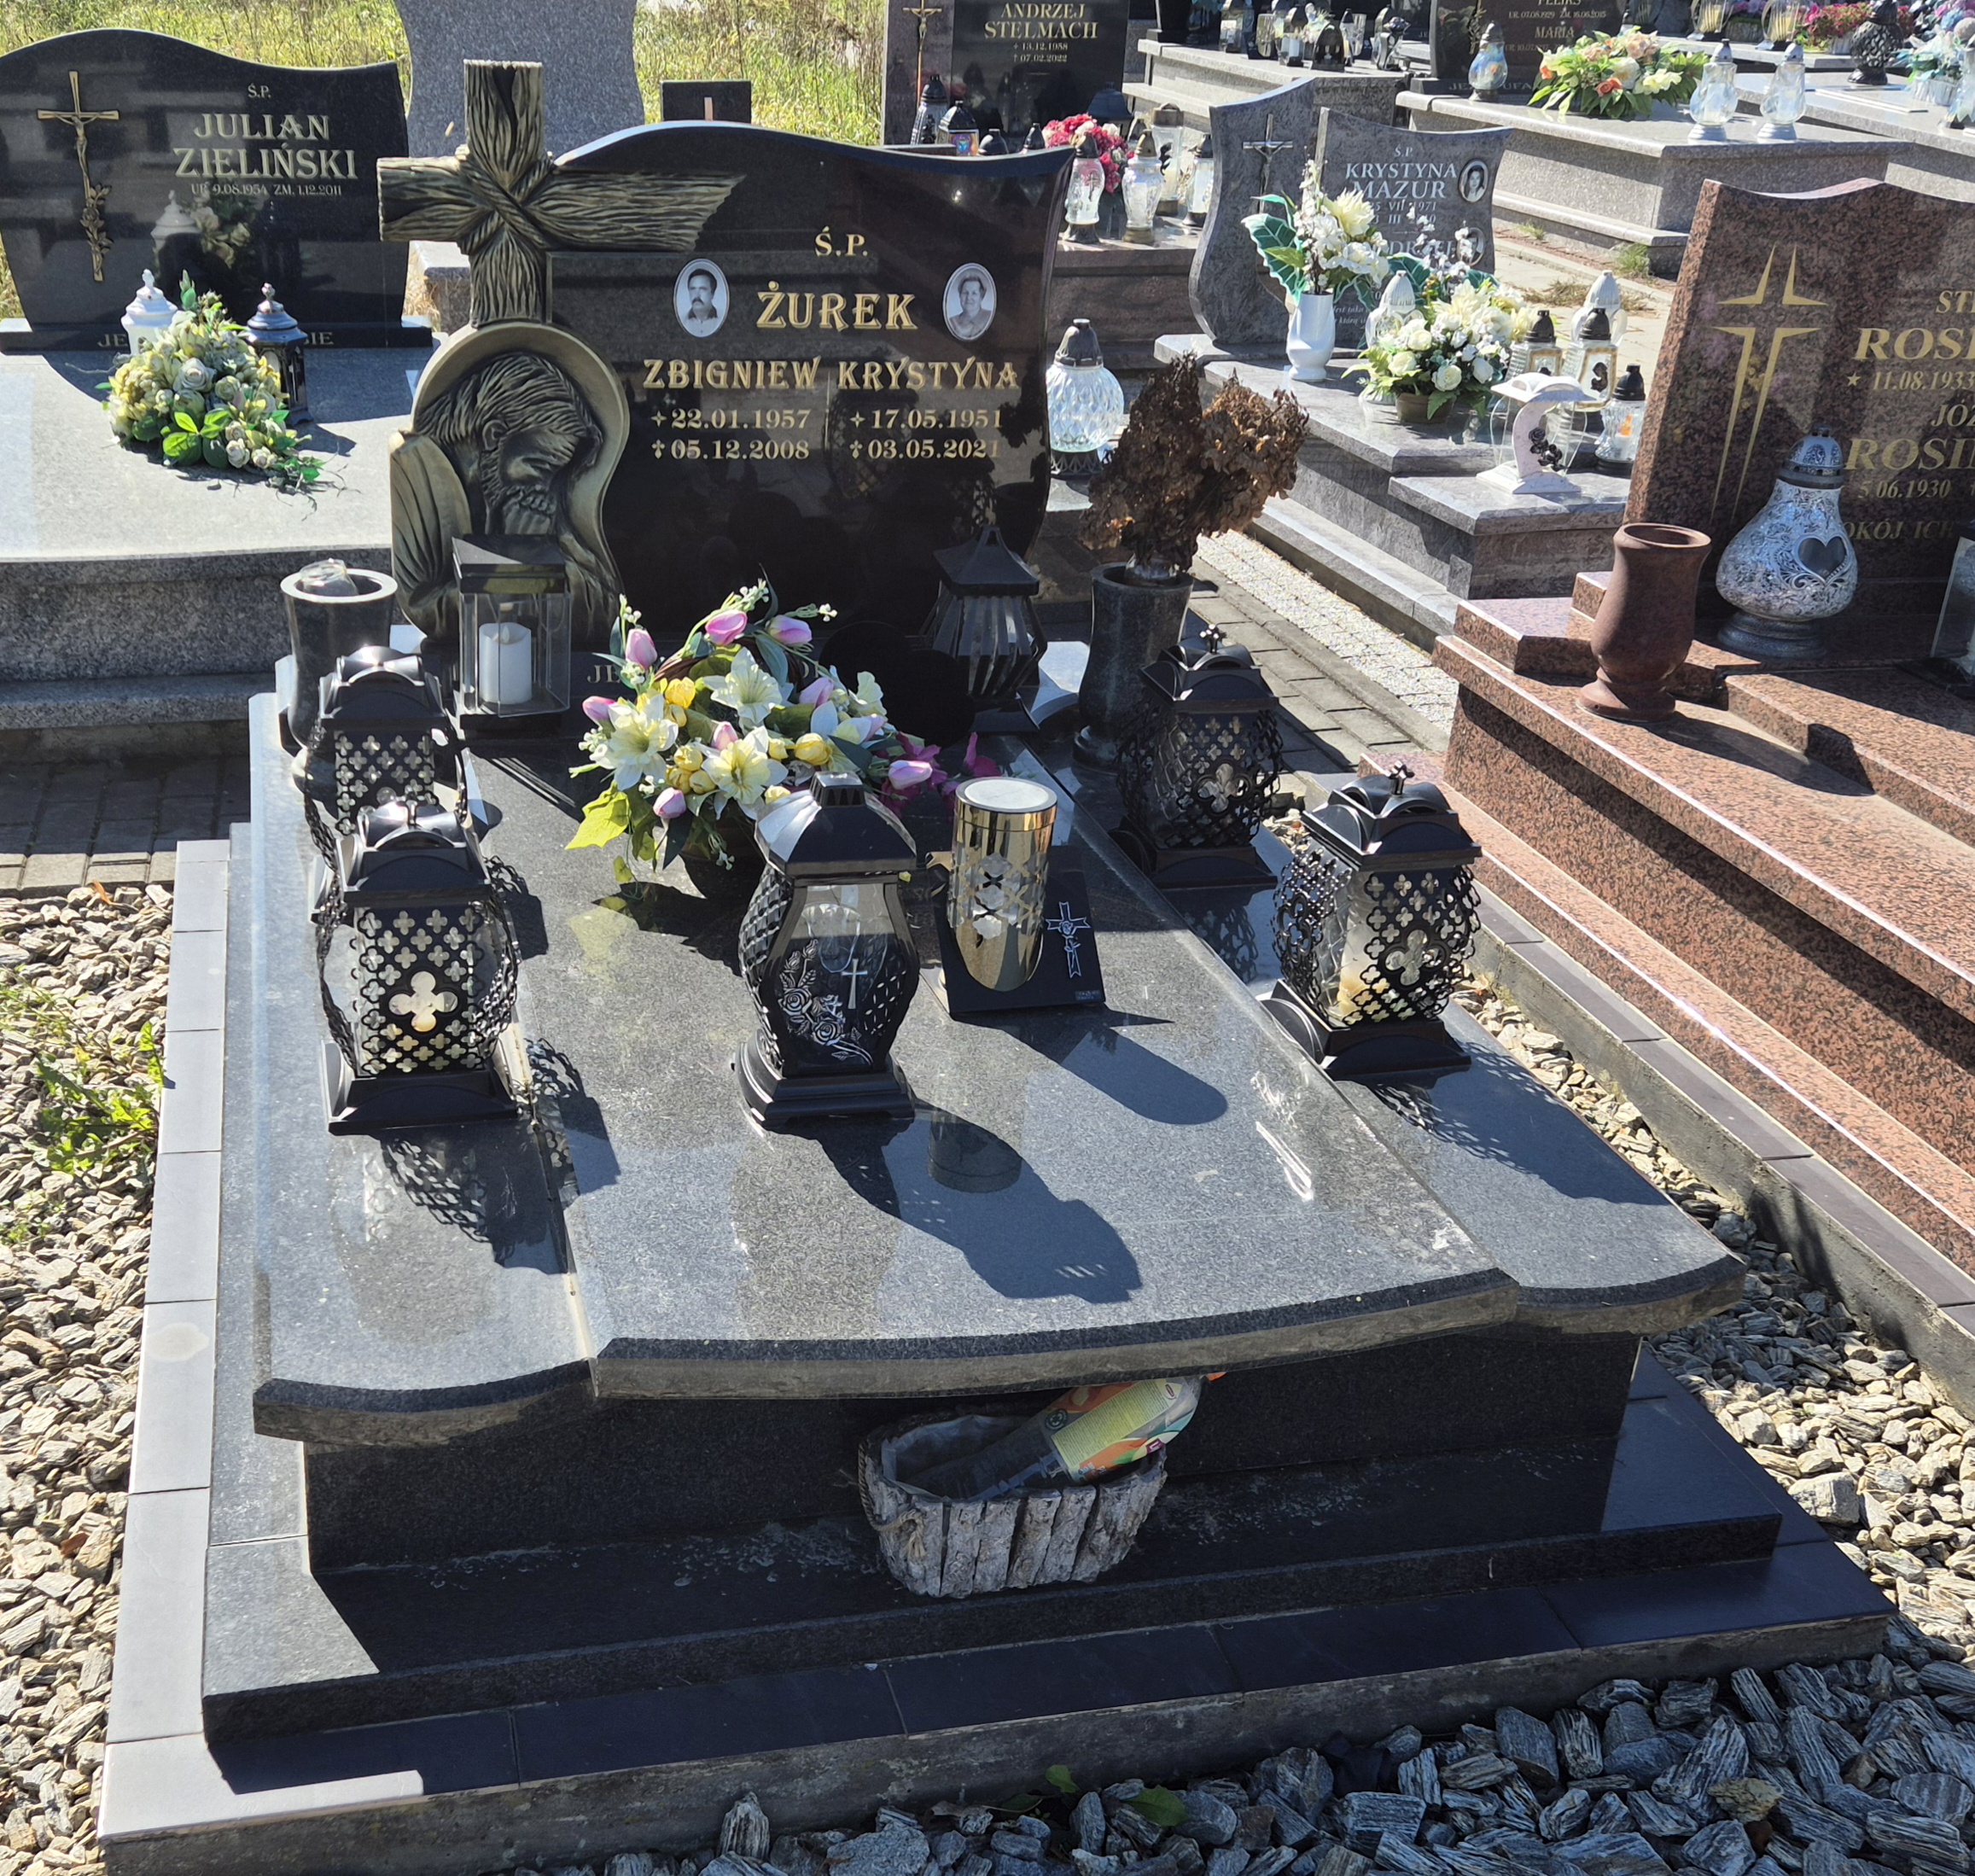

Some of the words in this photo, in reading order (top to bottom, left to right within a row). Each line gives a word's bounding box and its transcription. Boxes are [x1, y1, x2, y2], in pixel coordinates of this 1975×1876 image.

[1000, 3, 1086, 19] ANDRZEJ
[984, 20, 1098, 39] STELMACH
[1535, 26, 1575, 38] MARIA
[248, 83, 271, 98] Ś.P.
[1502, 82, 1531, 90] UFA
[194, 113, 330, 141] JULIAN
[172, 142, 358, 179] ZIELIŃSKI
[1345, 162, 1458, 179] KRYSTYNA
[273, 184, 295, 195] ZM.
[1354, 180, 1447, 200] MAZUR
[814, 226, 868, 257] Ś.P.
[756, 280, 919, 332] ŻUREK
[643, 356, 821, 389] ZBIGNIEW
[837, 356, 1020, 392] KRYSTYNA
[671, 408, 811, 429] 22.01.1957
[871, 408, 1003, 429] 17.05.1951
[671, 439, 810, 460] 05.12.2008
[867, 438, 1000, 459] 03.05.2021
[1844, 437, 1975, 470] ROSI
[1844, 517, 1904, 540] OKÓJ
